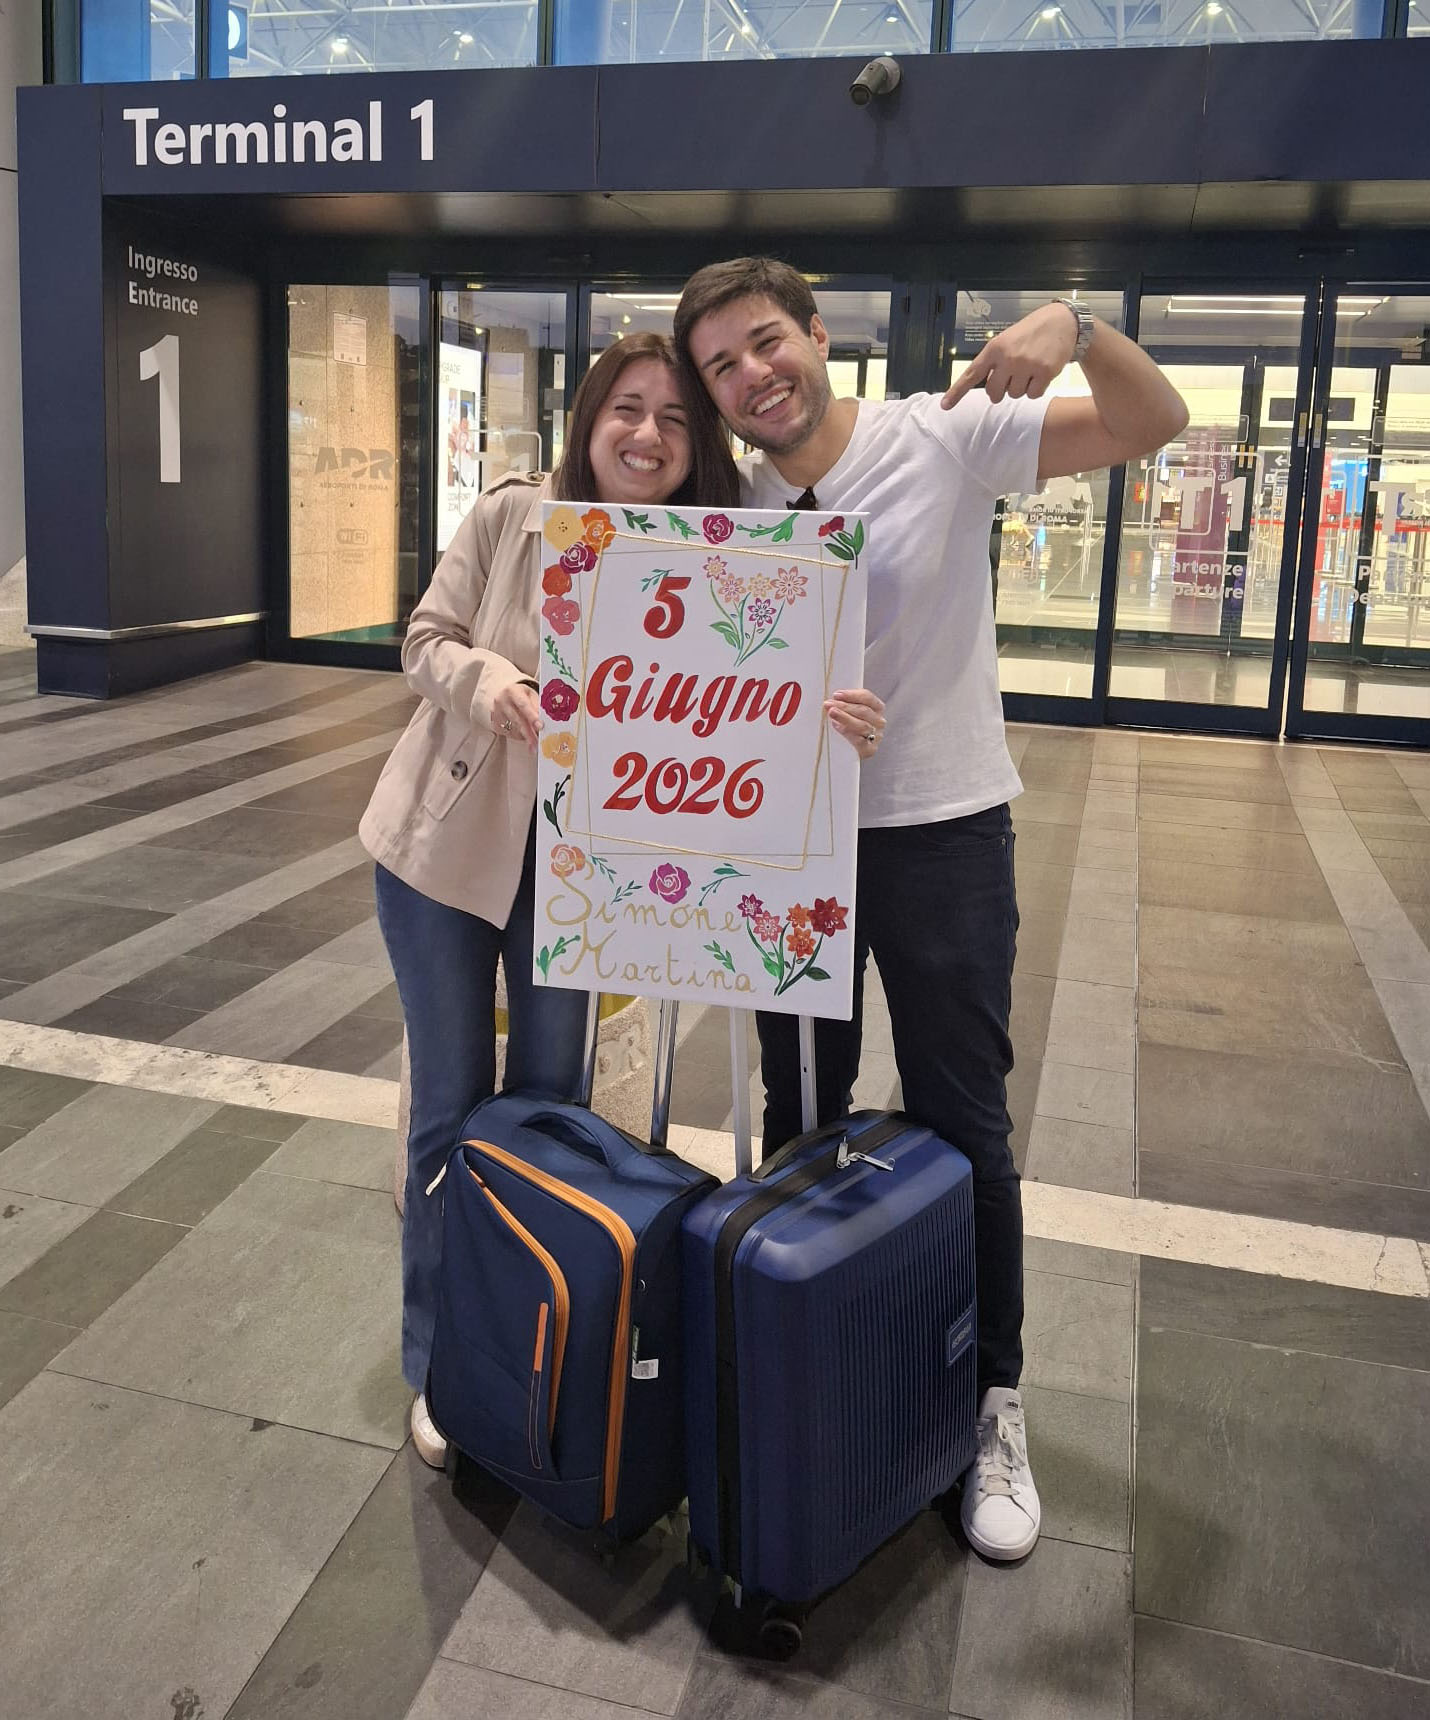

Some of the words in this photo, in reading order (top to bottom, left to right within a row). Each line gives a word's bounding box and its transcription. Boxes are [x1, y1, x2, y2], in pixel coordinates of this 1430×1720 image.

[123, 100, 382, 166] Terminal
[409, 99, 434, 161] 1
[128, 245, 198, 283] Ingresso
[128, 281, 199, 316] Entrance
[139, 334, 181, 483] 1
[315, 446, 395, 480] ADR
[643, 576, 692, 639] 5
[586, 655, 802, 738] Giugno
[602, 752, 766, 819] 2026
[546, 856, 746, 934] Simone
[560, 920, 757, 994] Martina
